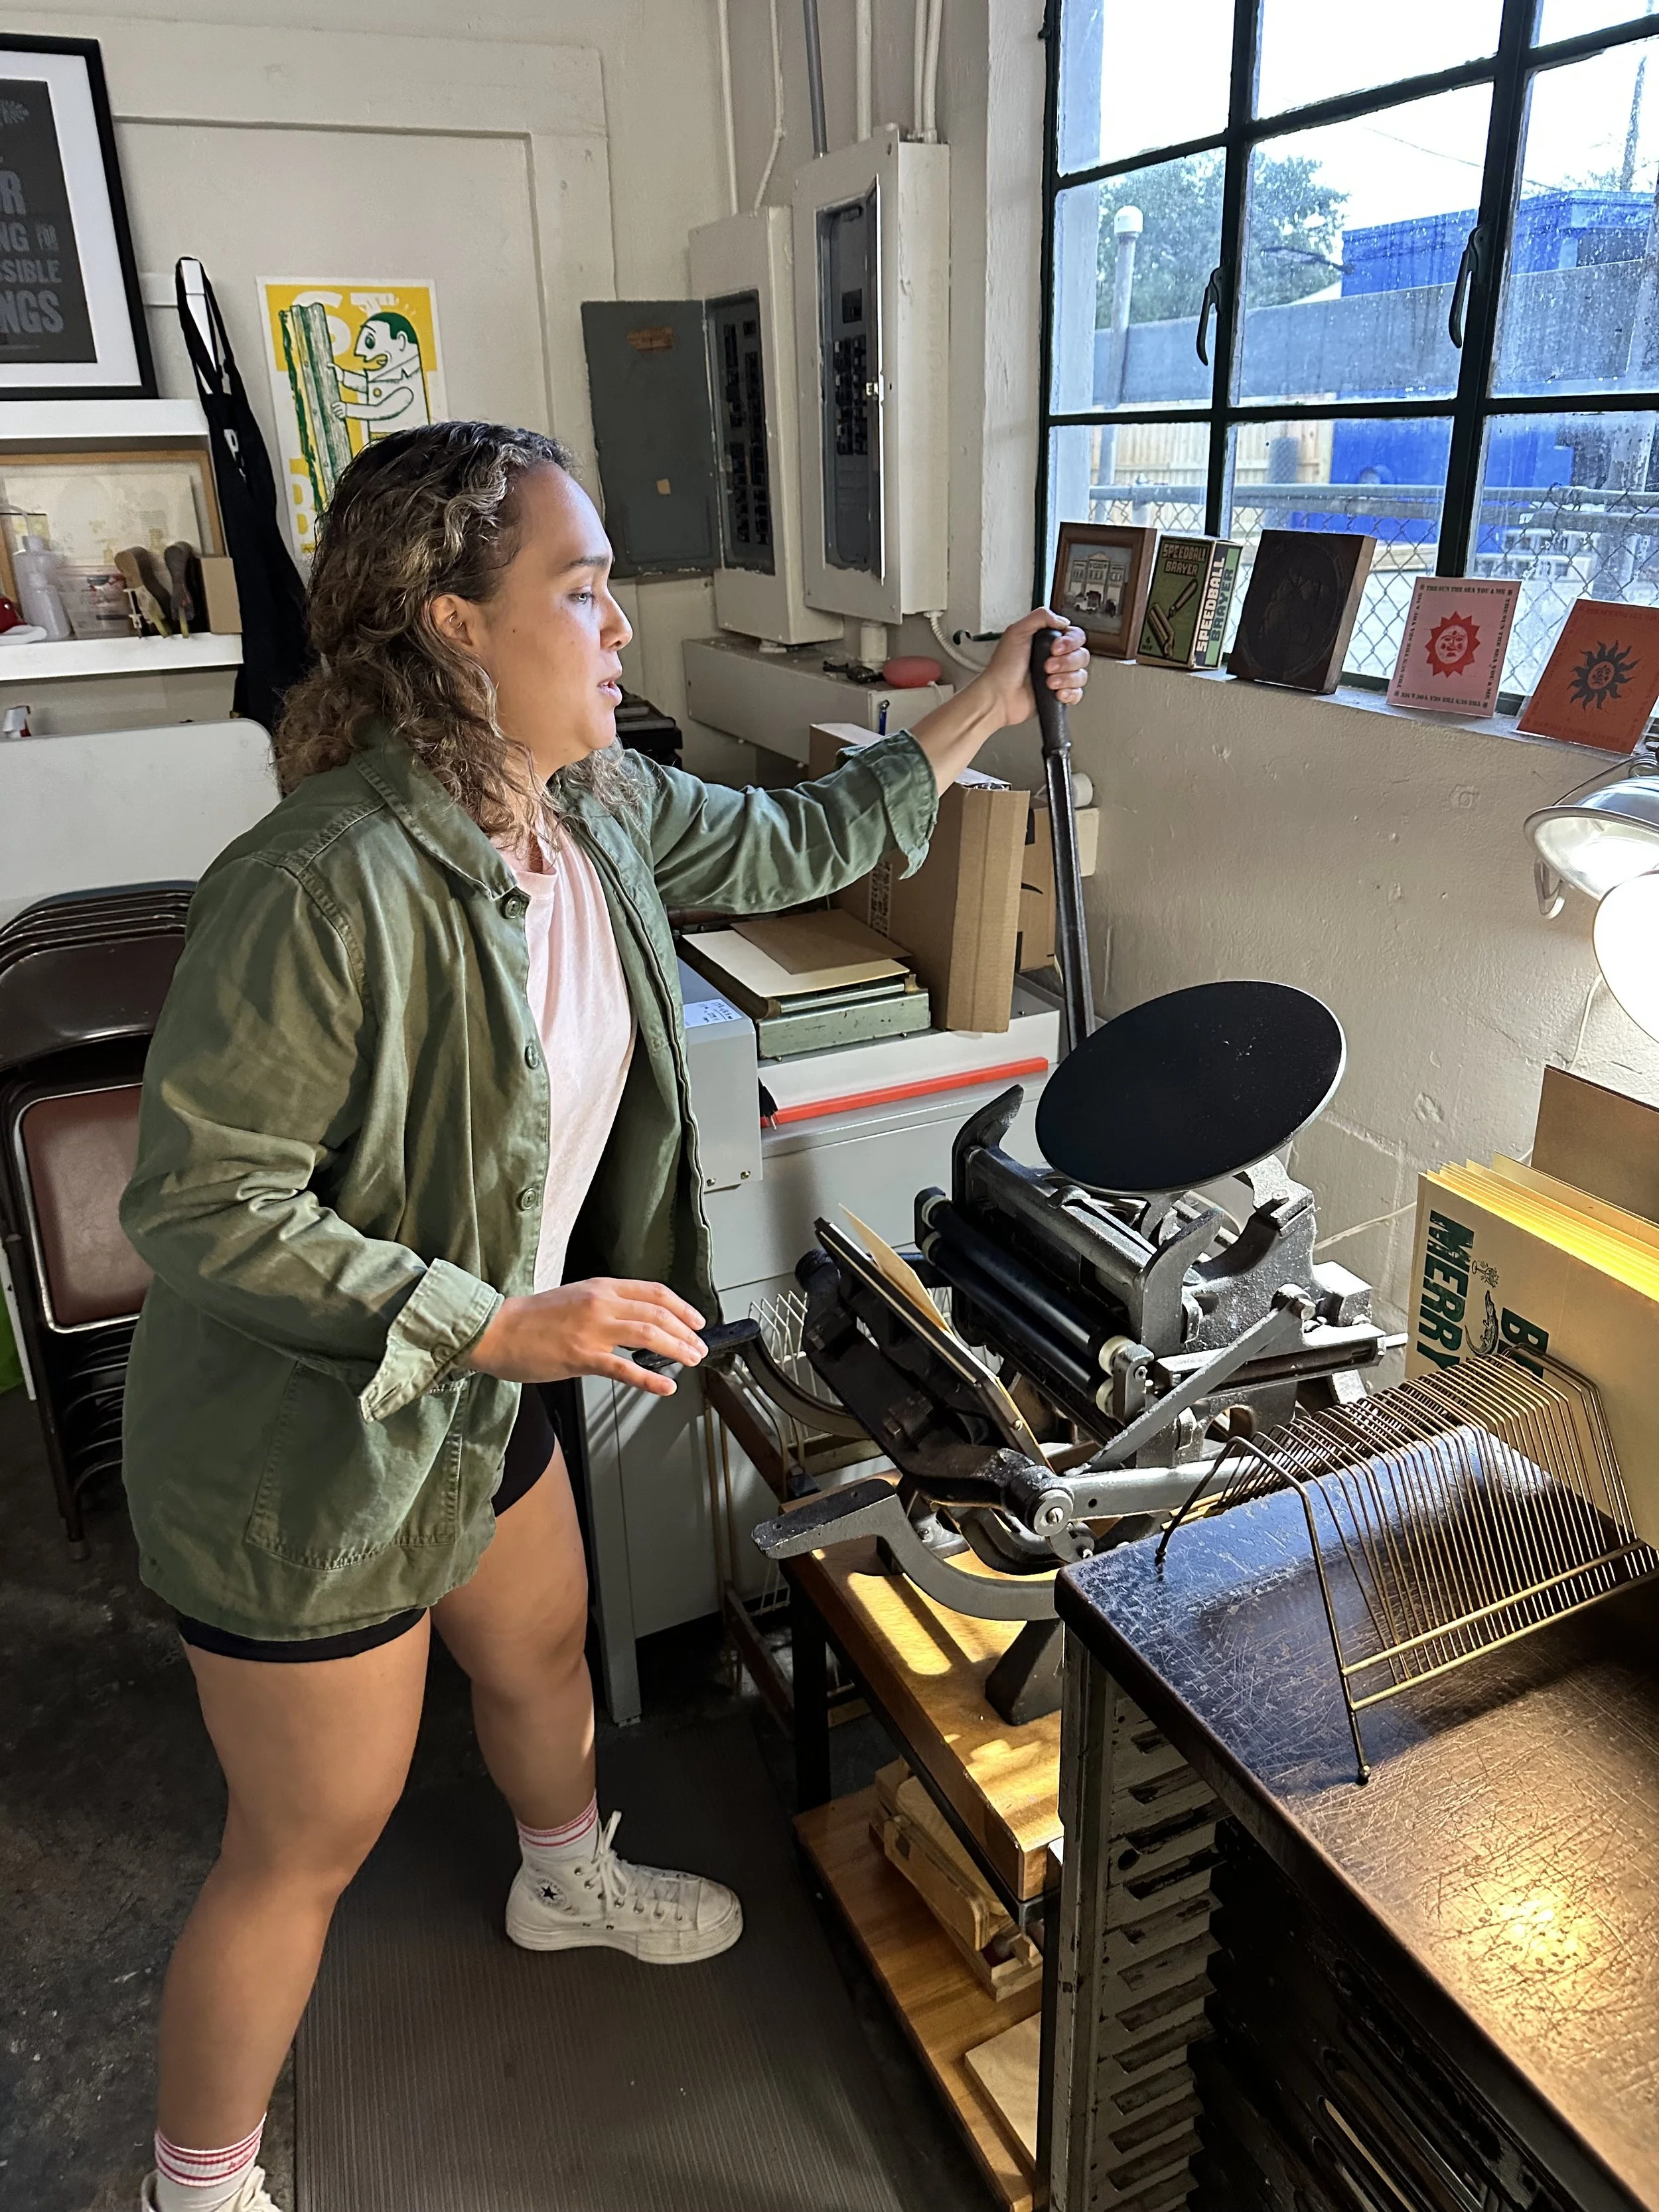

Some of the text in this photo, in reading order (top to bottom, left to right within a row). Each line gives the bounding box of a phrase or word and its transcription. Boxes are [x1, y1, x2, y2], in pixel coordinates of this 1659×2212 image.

[0, 170, 27, 214] R
[0, 259, 62, 283] SIBLE
[1163, 543, 1207, 562] SPEEDBALL
[1165, 560, 1198, 576] BRAYER
[1196, 557, 1225, 652] SPEEDBALL
[1210, 569, 1234, 642] BRAYER
[1416, 1209, 1475, 1370] MERRY
